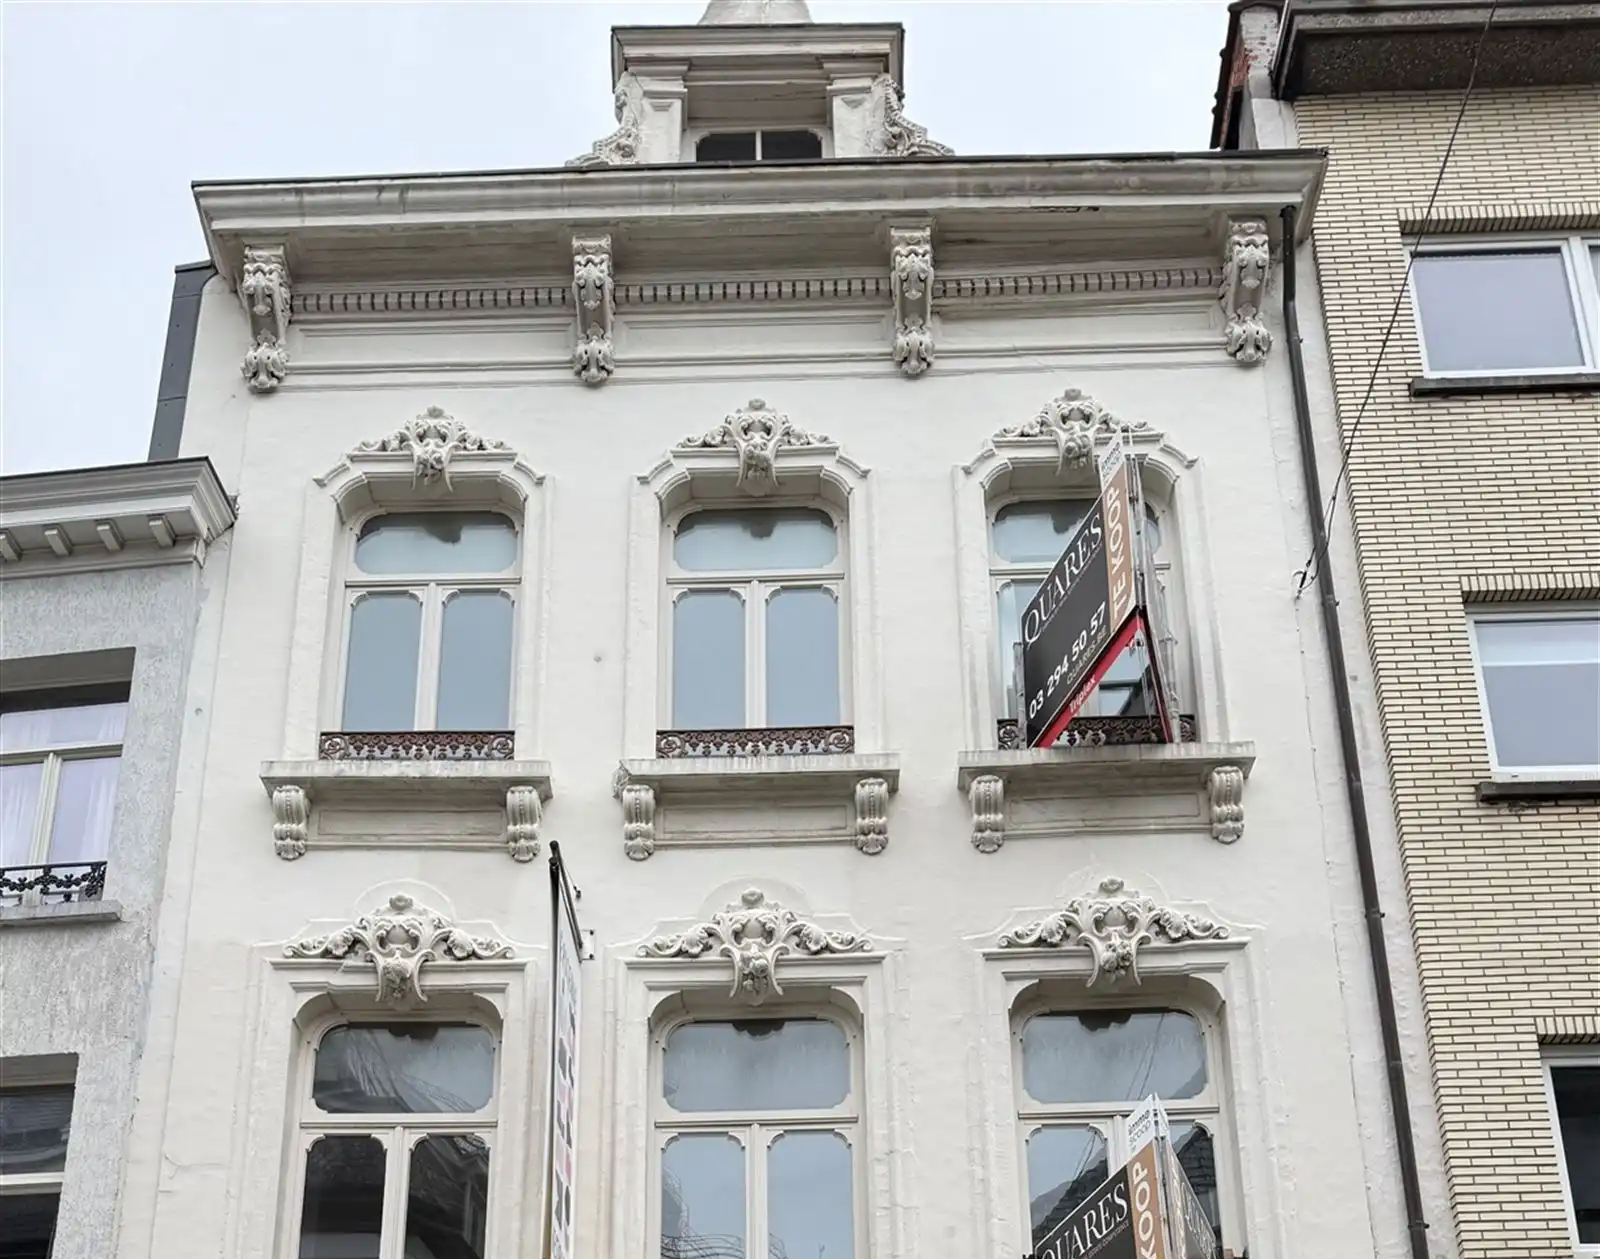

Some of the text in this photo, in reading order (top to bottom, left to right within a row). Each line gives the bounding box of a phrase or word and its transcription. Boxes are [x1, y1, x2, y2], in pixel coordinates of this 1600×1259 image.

[1024, 512, 1103, 647] QUARES
[1105, 486, 1128, 574] KOOP
[1113, 578, 1132, 621] TE
[1028, 601, 1106, 720] 03 294 50 57
